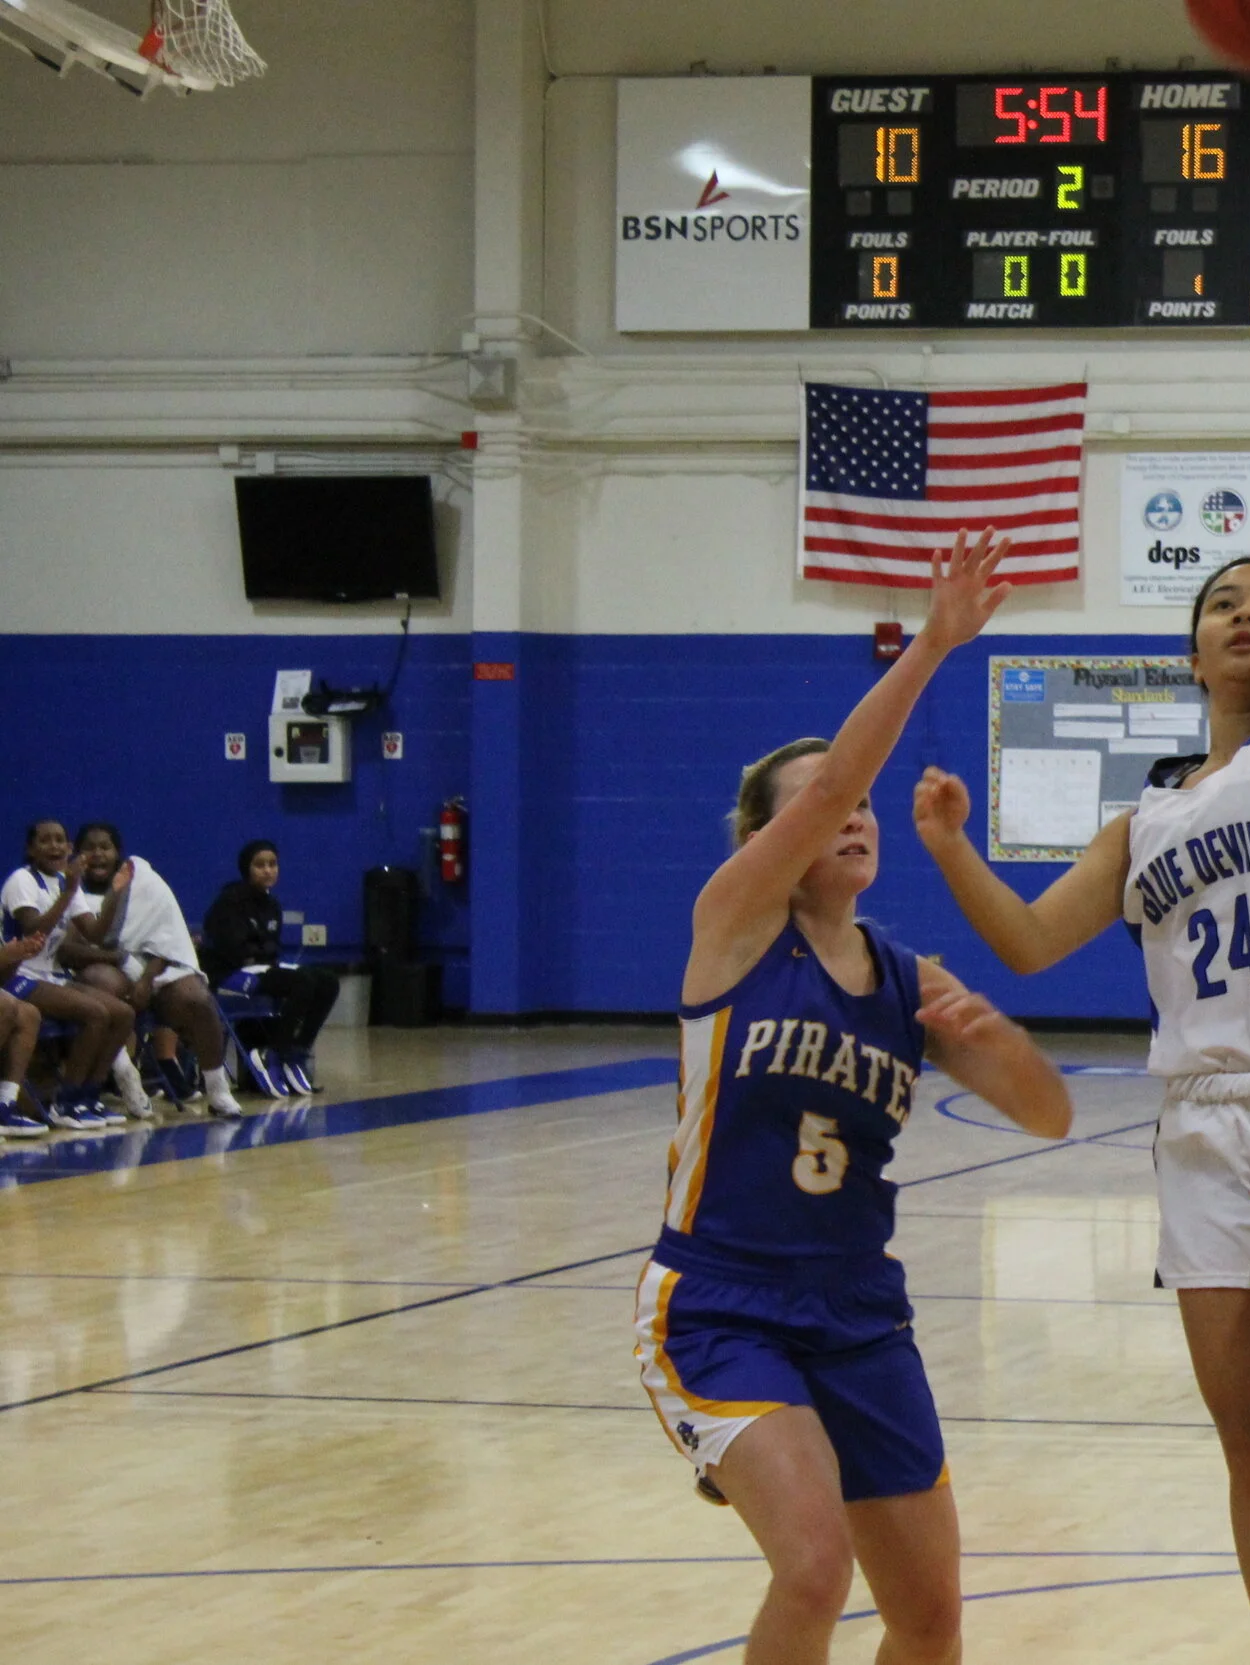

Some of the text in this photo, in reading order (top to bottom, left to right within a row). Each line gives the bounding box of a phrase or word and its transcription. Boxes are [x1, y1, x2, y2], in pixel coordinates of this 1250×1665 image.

[830, 87, 930, 113] GUEST
[1140, 83, 1231, 109] HOME
[994, 87, 1107, 143] 5:54
[875, 127, 920, 183] 10
[1182, 123, 1225, 180] 16
[952, 178, 1040, 199] PERIOD
[1057, 166, 1083, 209] 2
[850, 231, 909, 249] FOULS
[966, 230, 1095, 247] PLAYER-FOUL
[1154, 229, 1214, 246] FOULS
[873, 256, 898, 298] 0
[1003, 253, 1086, 297] 0 0
[844, 303, 912, 320] POINTS
[967, 303, 1034, 319] MATCH
[1148, 301, 1216, 318] POINTS
[1148, 540, 1200, 570] dcps
[735, 1018, 917, 1127] PIRATE
[792, 1111, 850, 1194] 5
